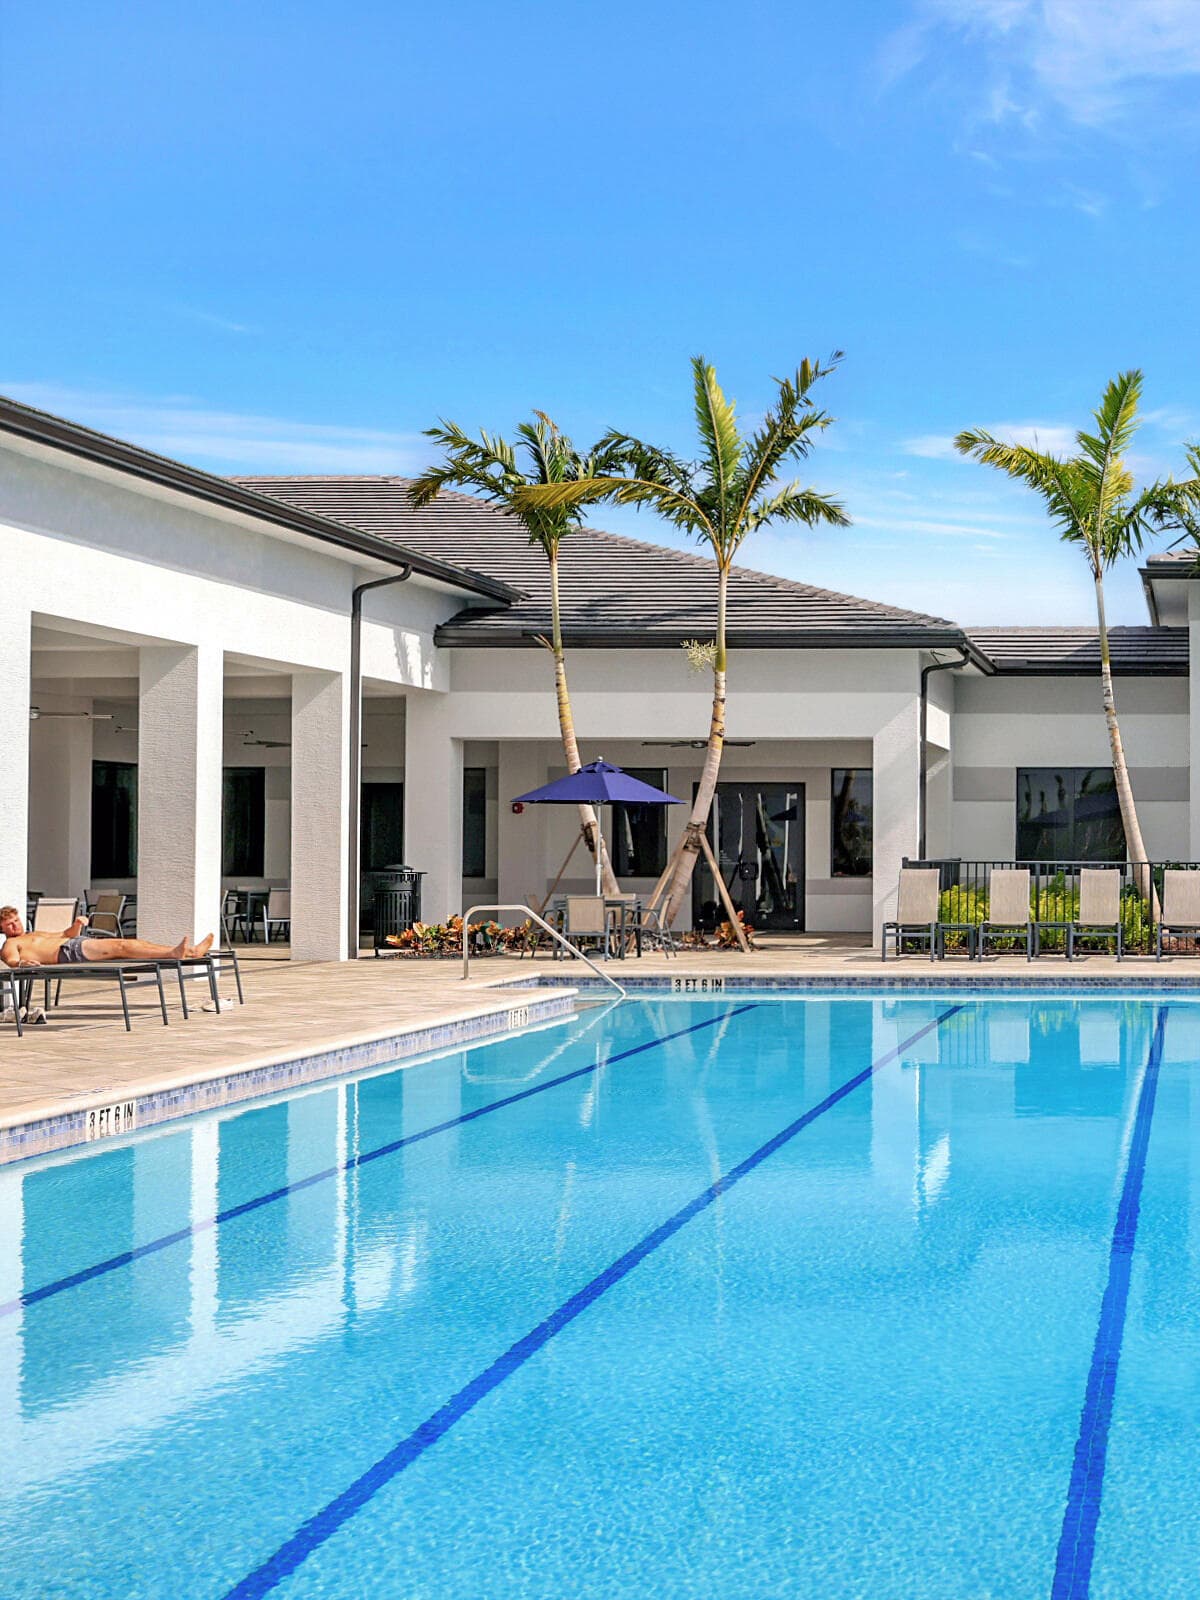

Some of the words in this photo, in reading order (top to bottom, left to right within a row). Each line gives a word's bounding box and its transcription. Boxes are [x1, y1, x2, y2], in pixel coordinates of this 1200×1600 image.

[675, 979, 681, 987] 3
[685, 979, 698, 987] FT
[711, 979, 722, 987] IN
[90, 1112, 95, 1127] 3
[99, 1108, 110, 1124] FT
[115, 1106, 120, 1120] 6
[124, 1102, 133, 1118] IN
